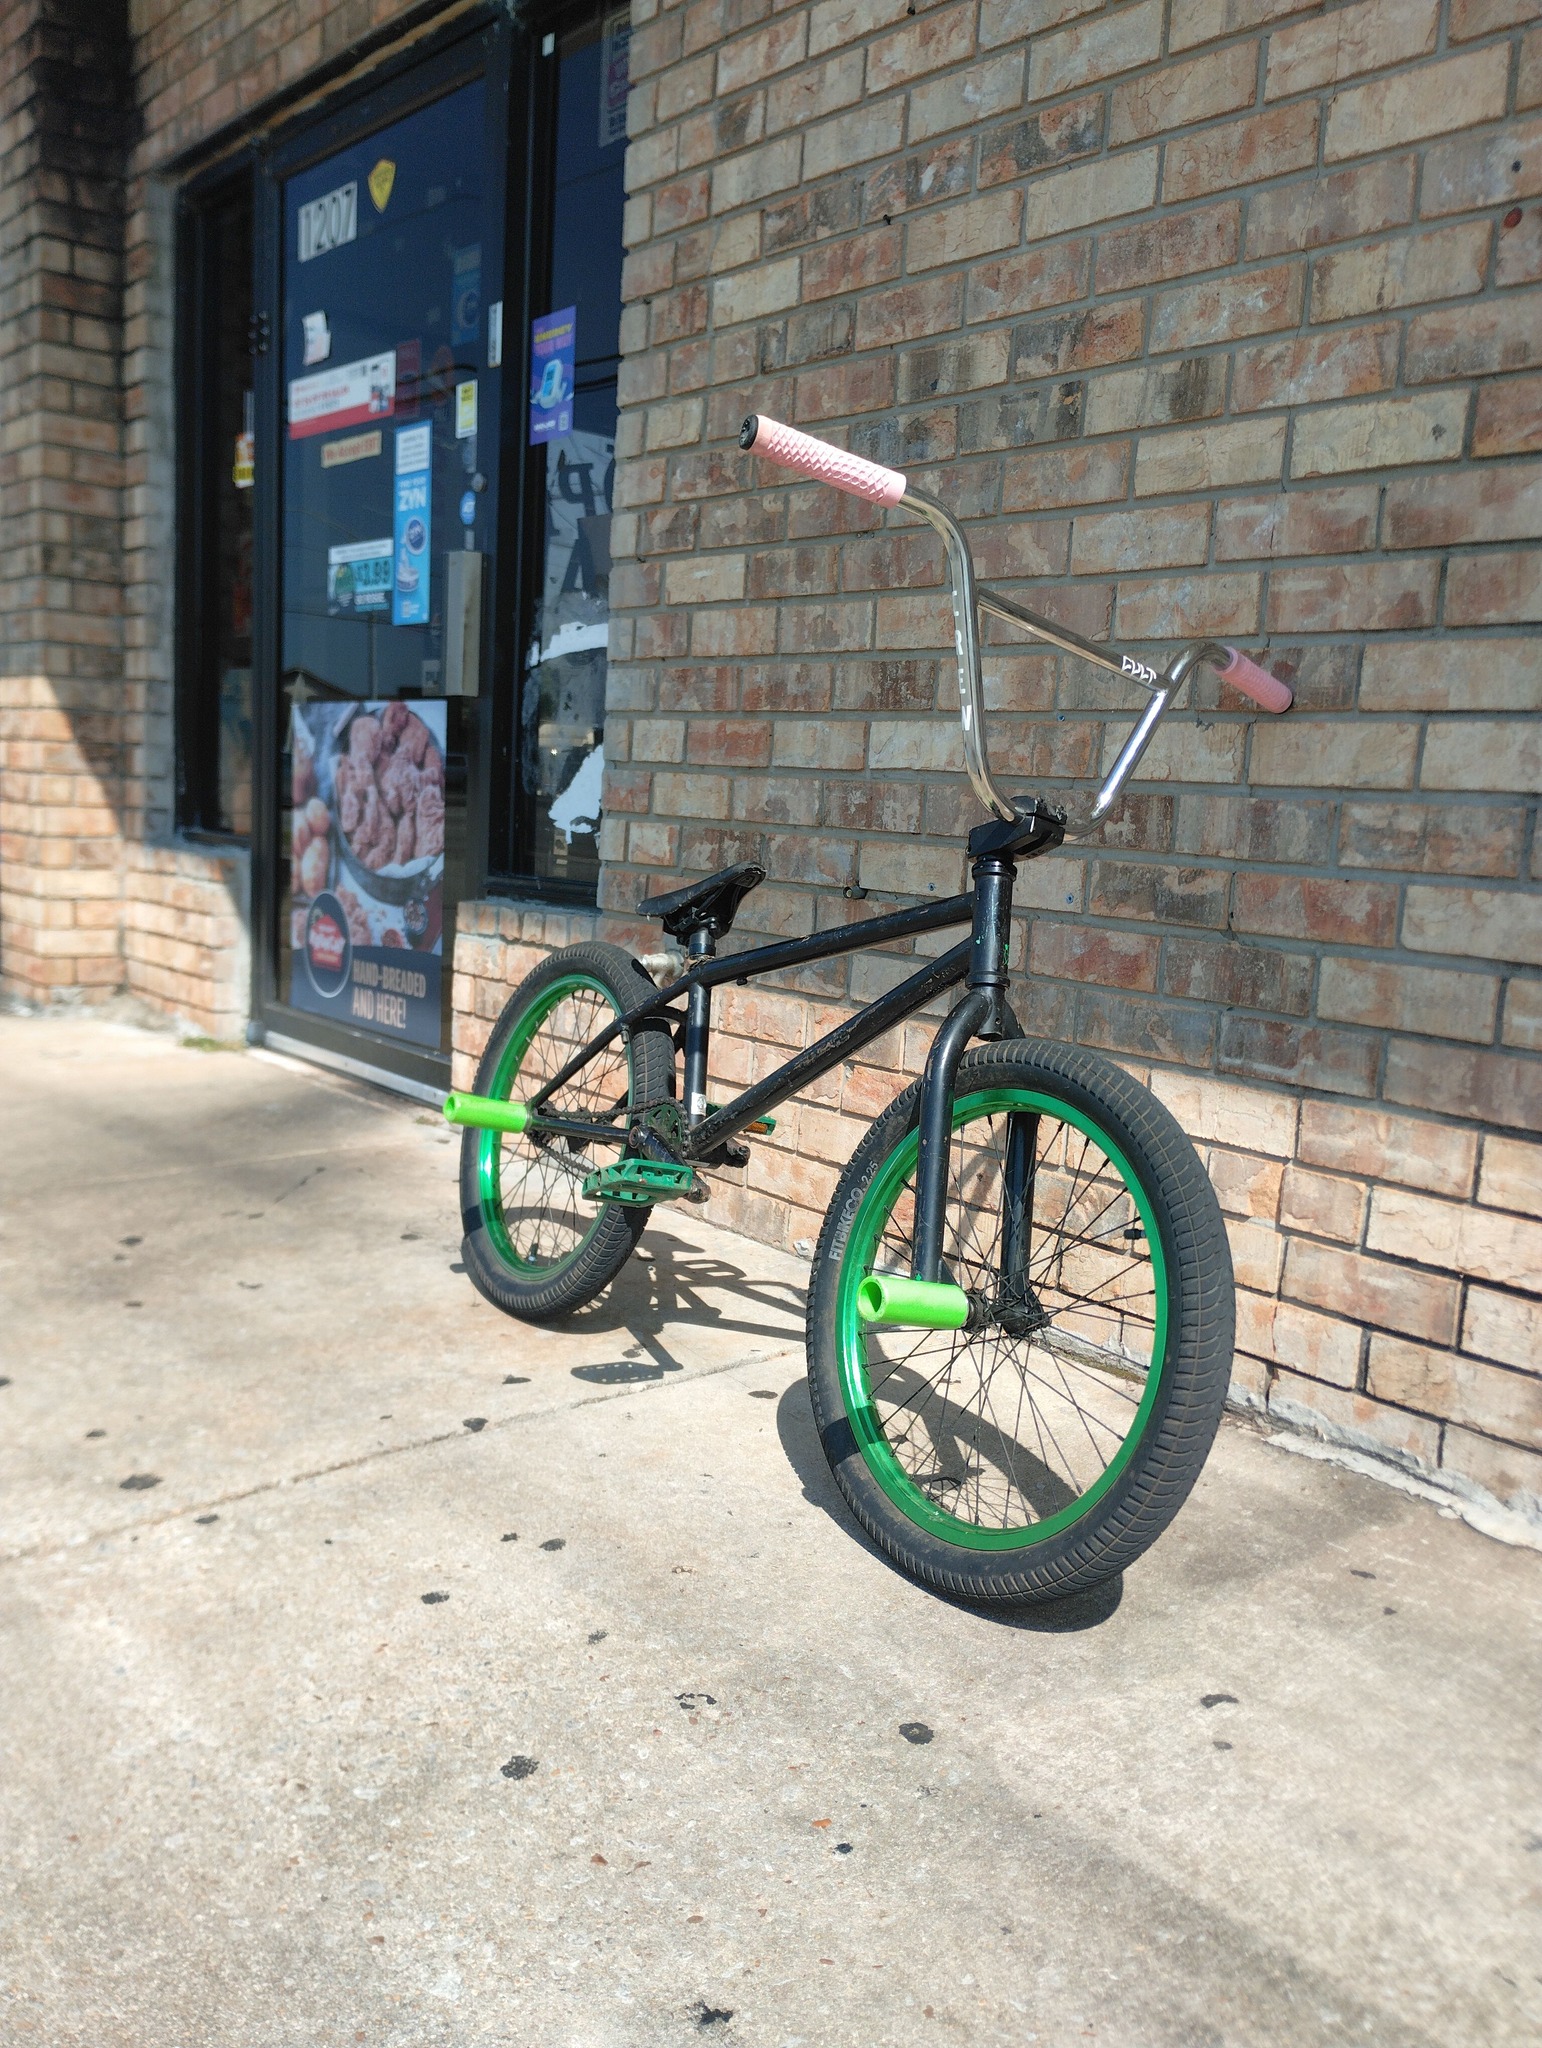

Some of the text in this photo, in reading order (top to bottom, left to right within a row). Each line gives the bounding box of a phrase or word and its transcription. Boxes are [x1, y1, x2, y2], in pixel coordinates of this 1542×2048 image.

[303, 188, 353, 257] 1207
[398, 486, 427, 511] ZYN
[1121, 655, 1157, 687] CULT
[353, 958, 427, 999] HAND-BREADED
[352, 986, 407, 1030] AND HERE!
[860, 1160, 879, 1186] 2.25
